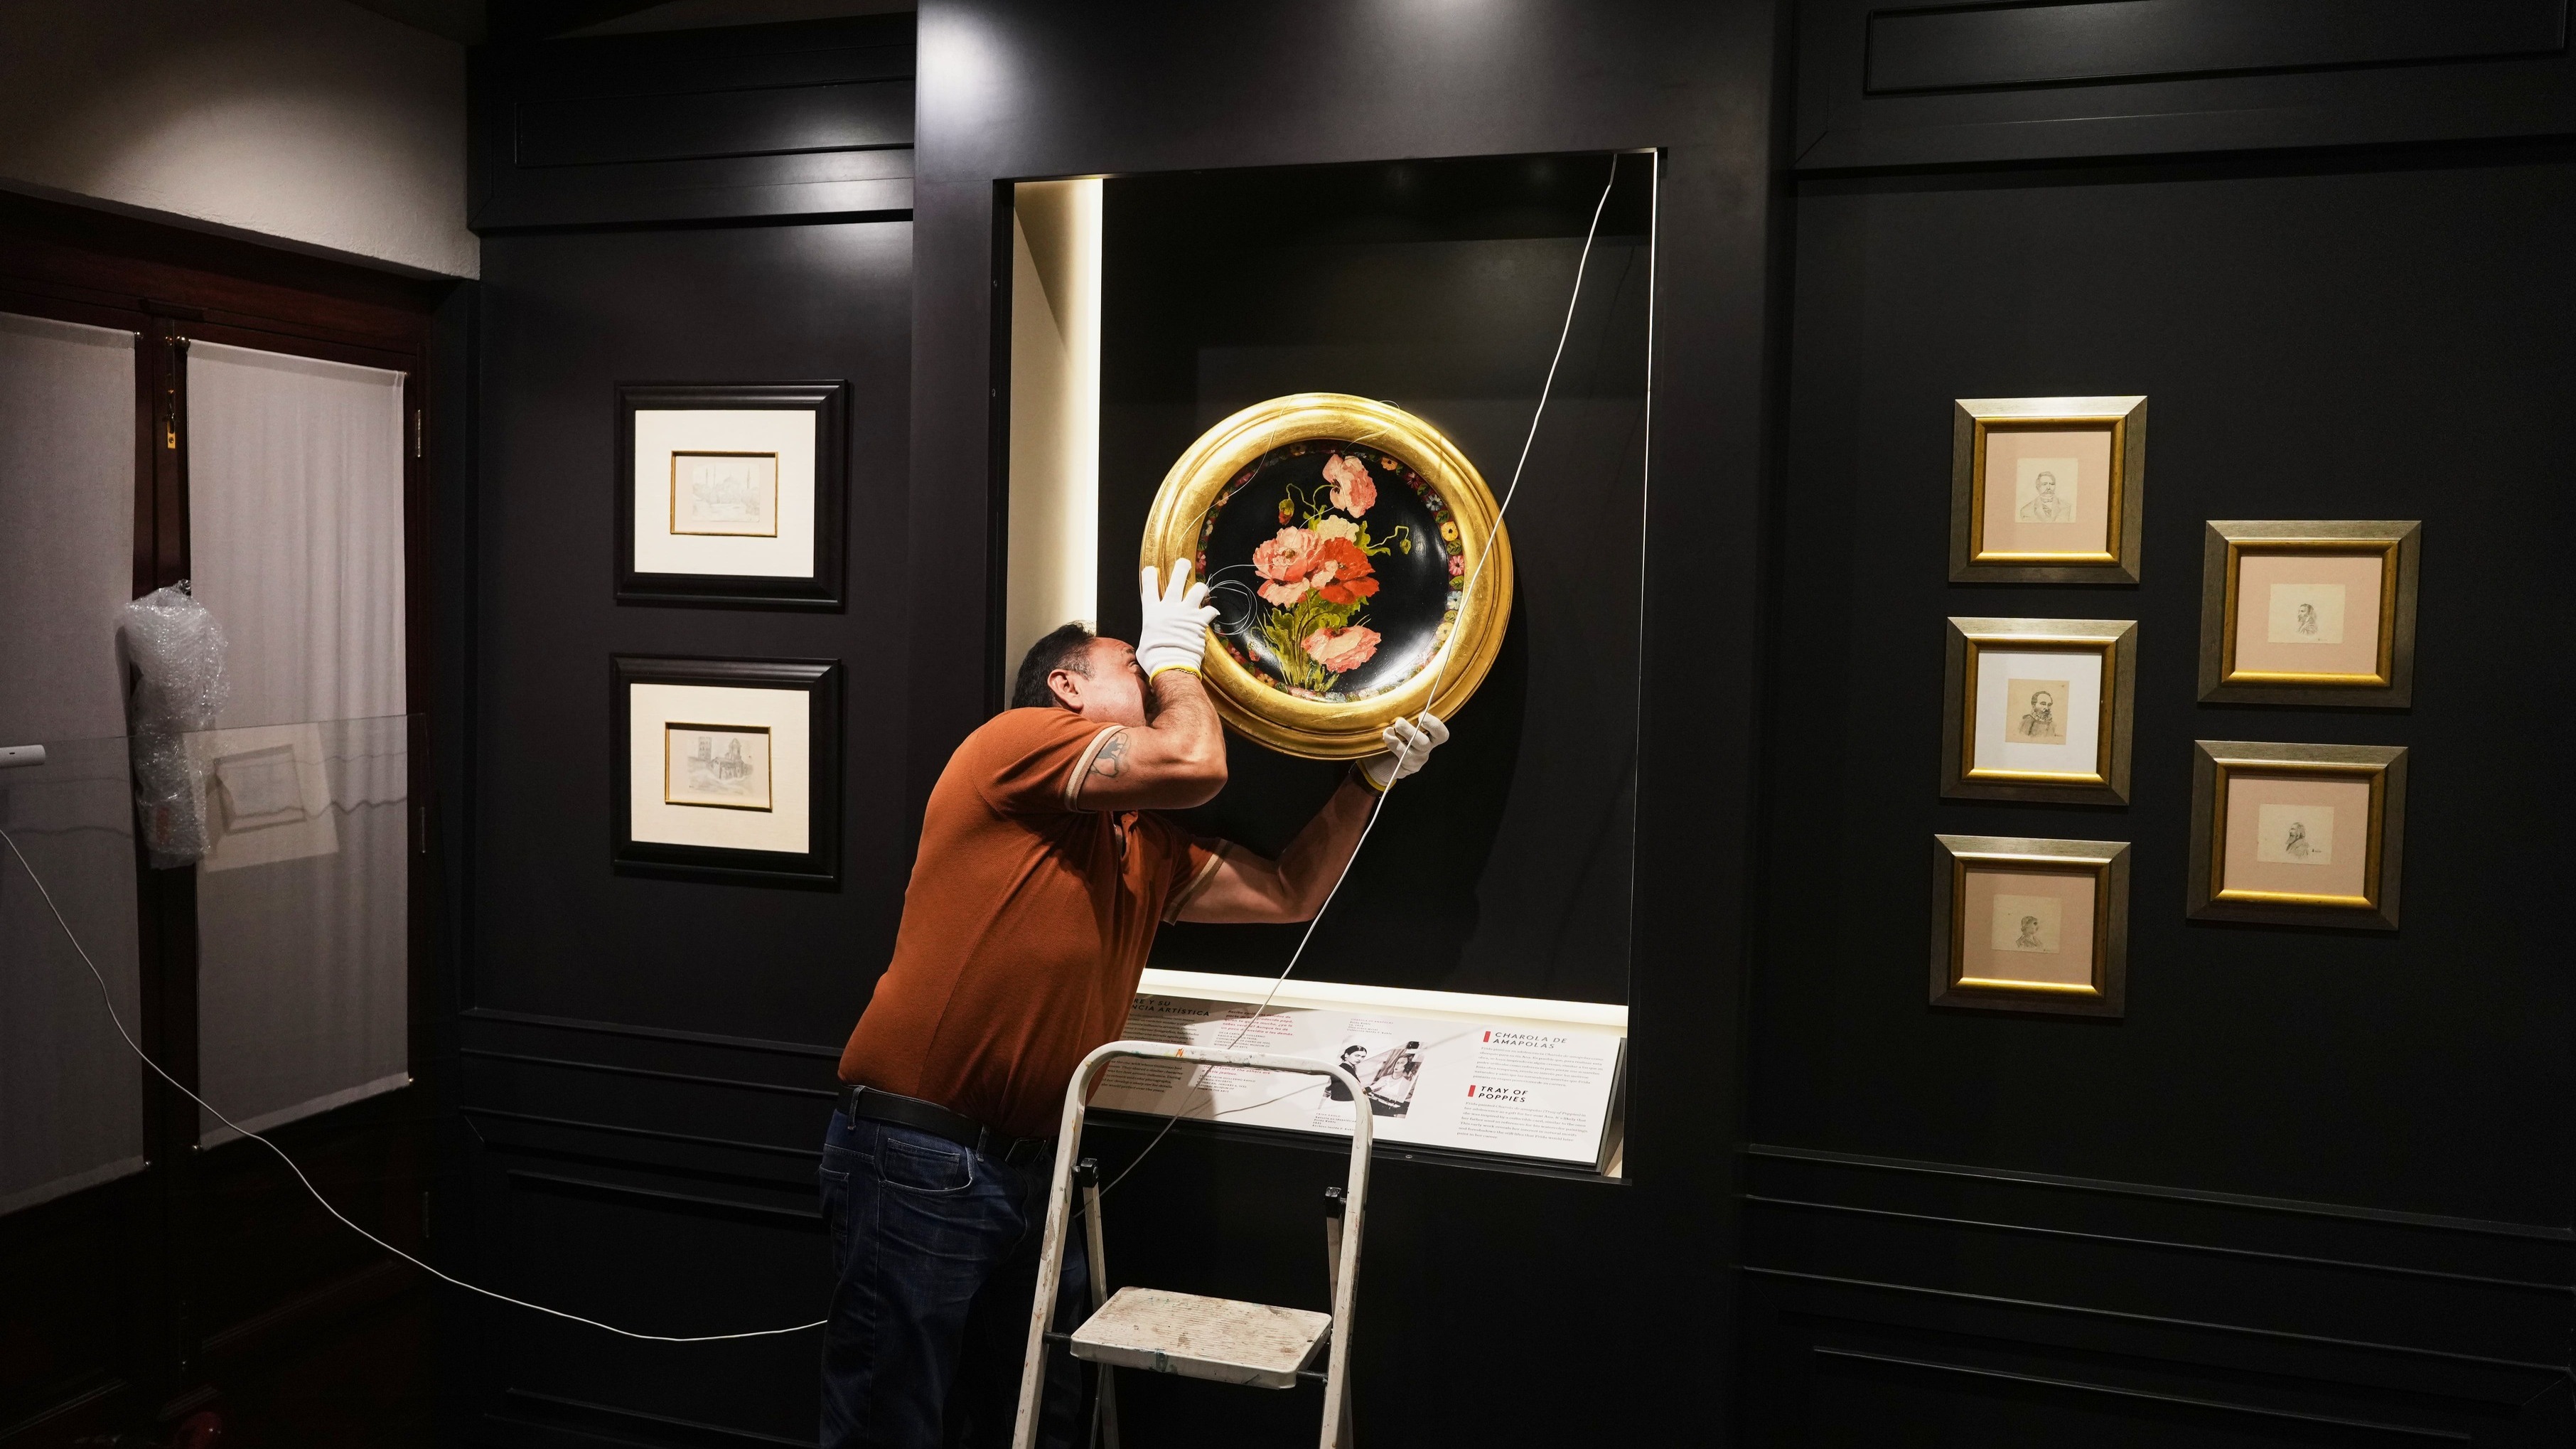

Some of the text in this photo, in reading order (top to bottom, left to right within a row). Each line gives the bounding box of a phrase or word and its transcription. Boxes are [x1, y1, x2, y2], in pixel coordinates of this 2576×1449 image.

[1158, 1006, 1210, 1017] ARTÍSTICA
[1495, 1032, 1548, 1042] CHAROLA
[1493, 1039, 1555, 1049] AMAPOLAS
[1478, 1093, 1526, 1103] POPPIES
